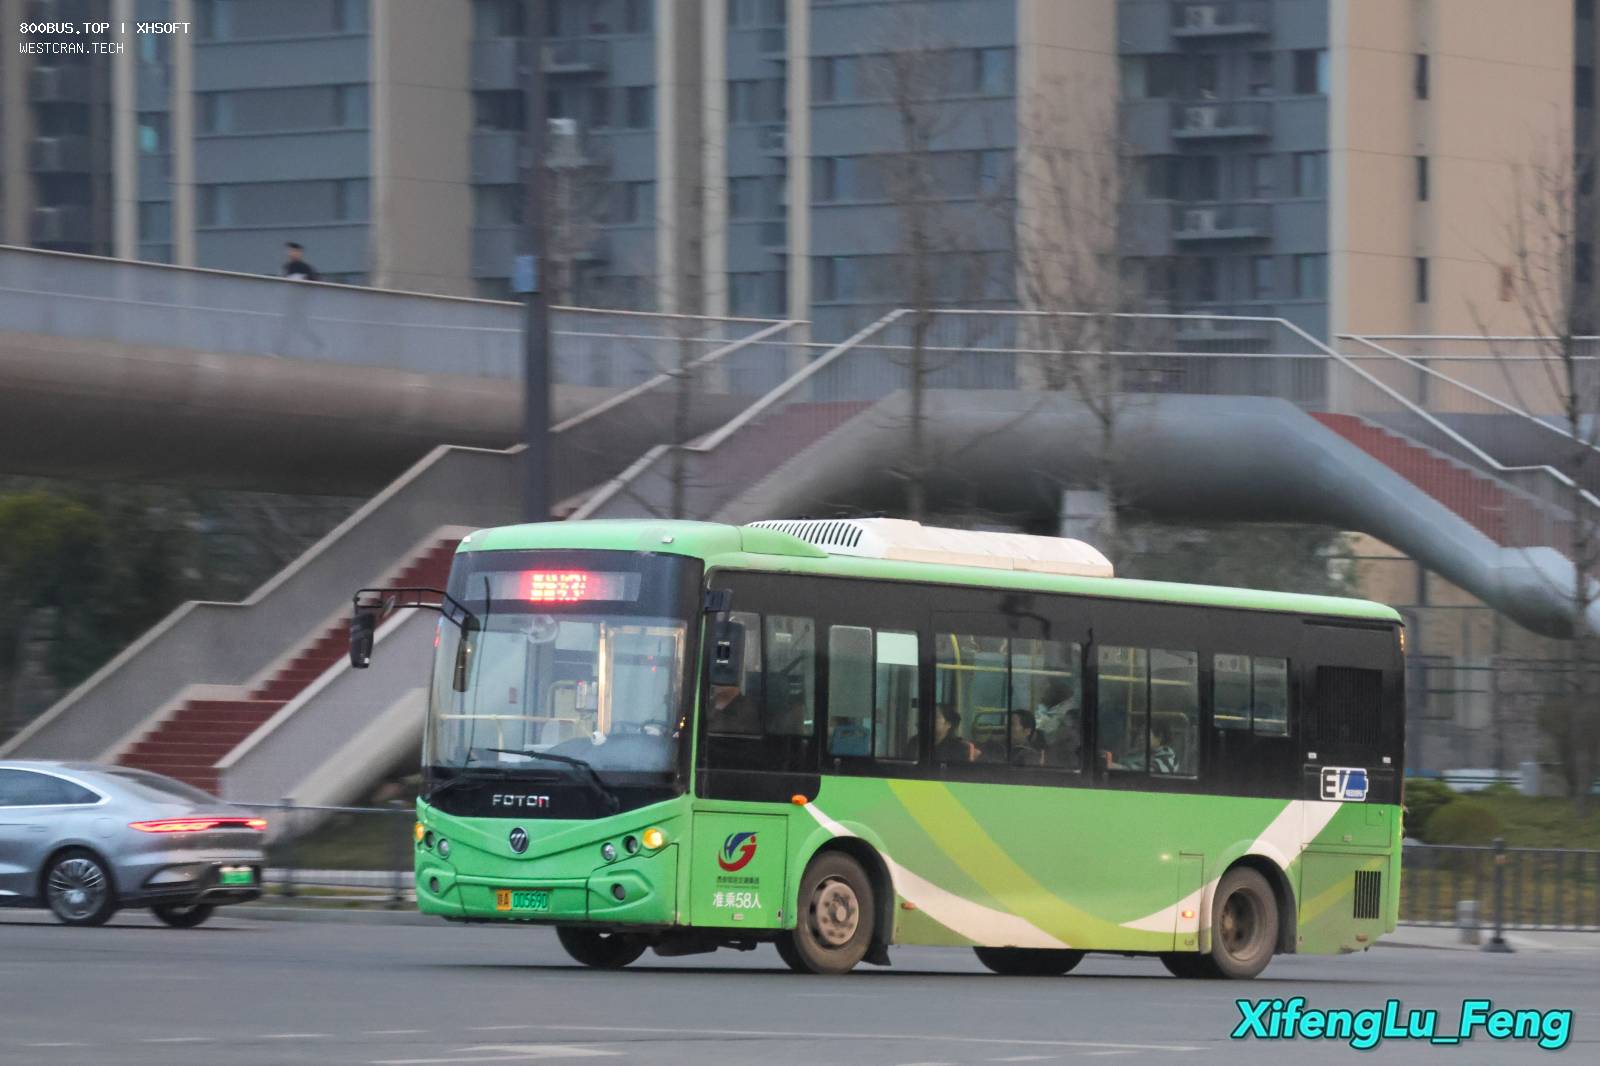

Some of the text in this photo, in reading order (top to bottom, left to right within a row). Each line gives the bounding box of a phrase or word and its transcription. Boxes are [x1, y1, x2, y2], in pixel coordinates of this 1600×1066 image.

[492, 794, 550, 808] FOTON
[712, 891, 762, 909] 准乘58人
